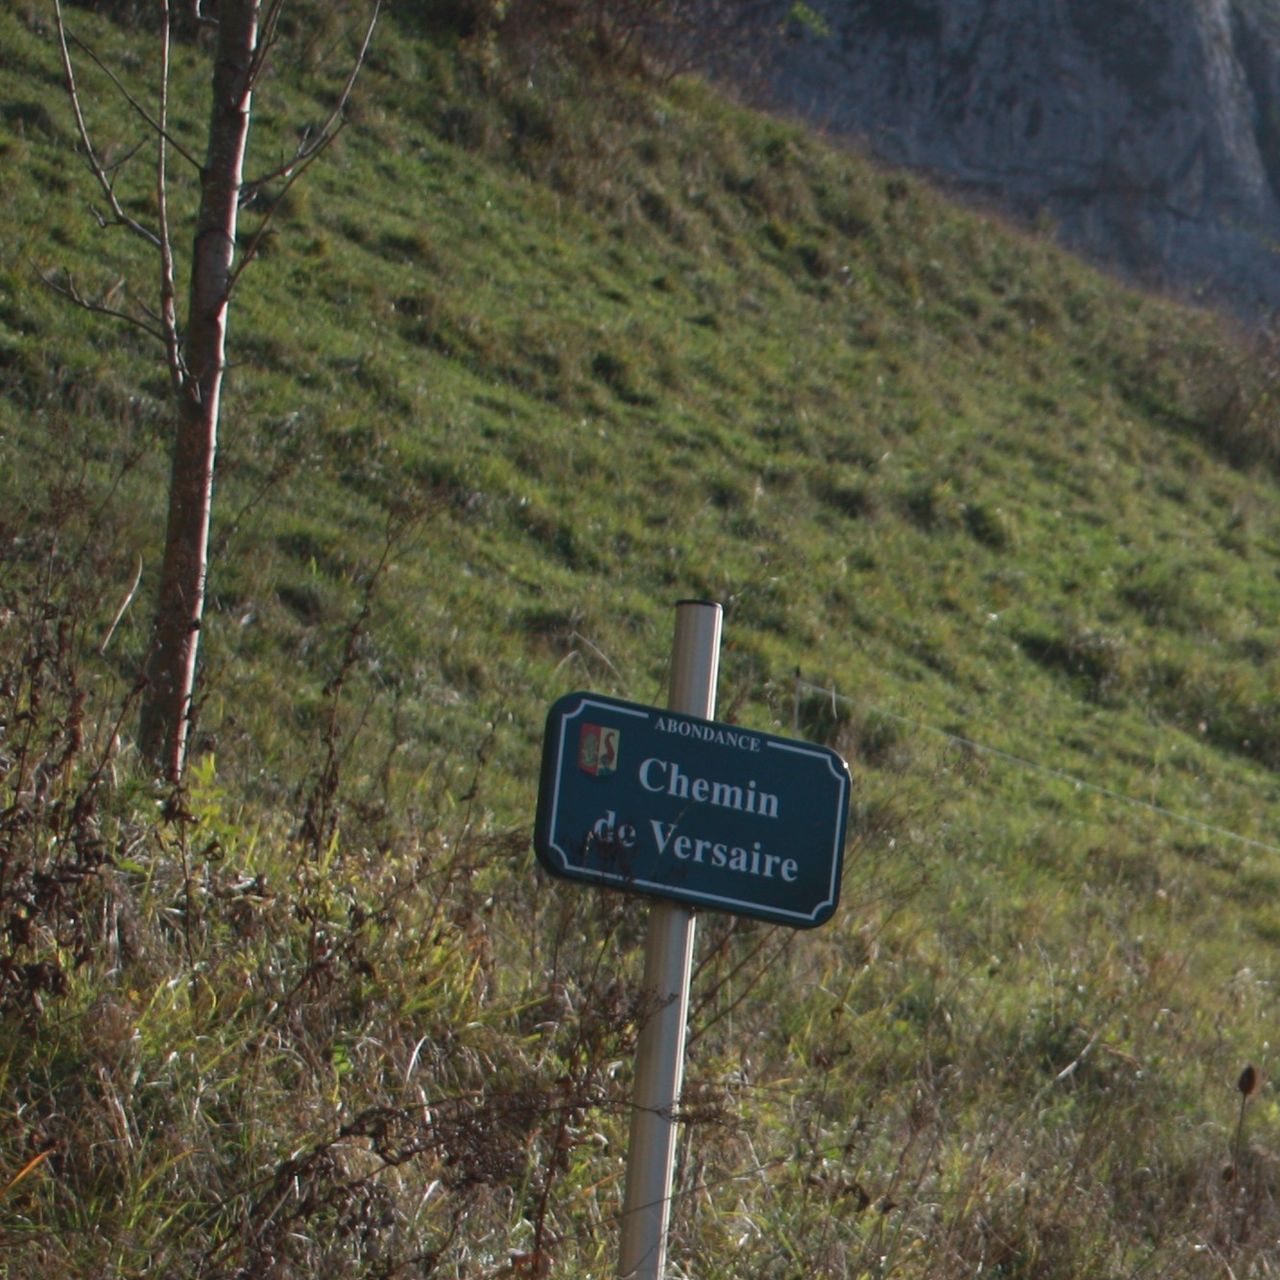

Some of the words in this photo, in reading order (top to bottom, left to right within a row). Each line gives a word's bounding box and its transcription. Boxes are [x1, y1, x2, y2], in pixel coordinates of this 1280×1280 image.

[654, 717, 761, 752] ABONDANCE
[639, 757, 780, 819] Chemin
[592, 808, 637, 848] de
[649, 819, 799, 882] Versaire
